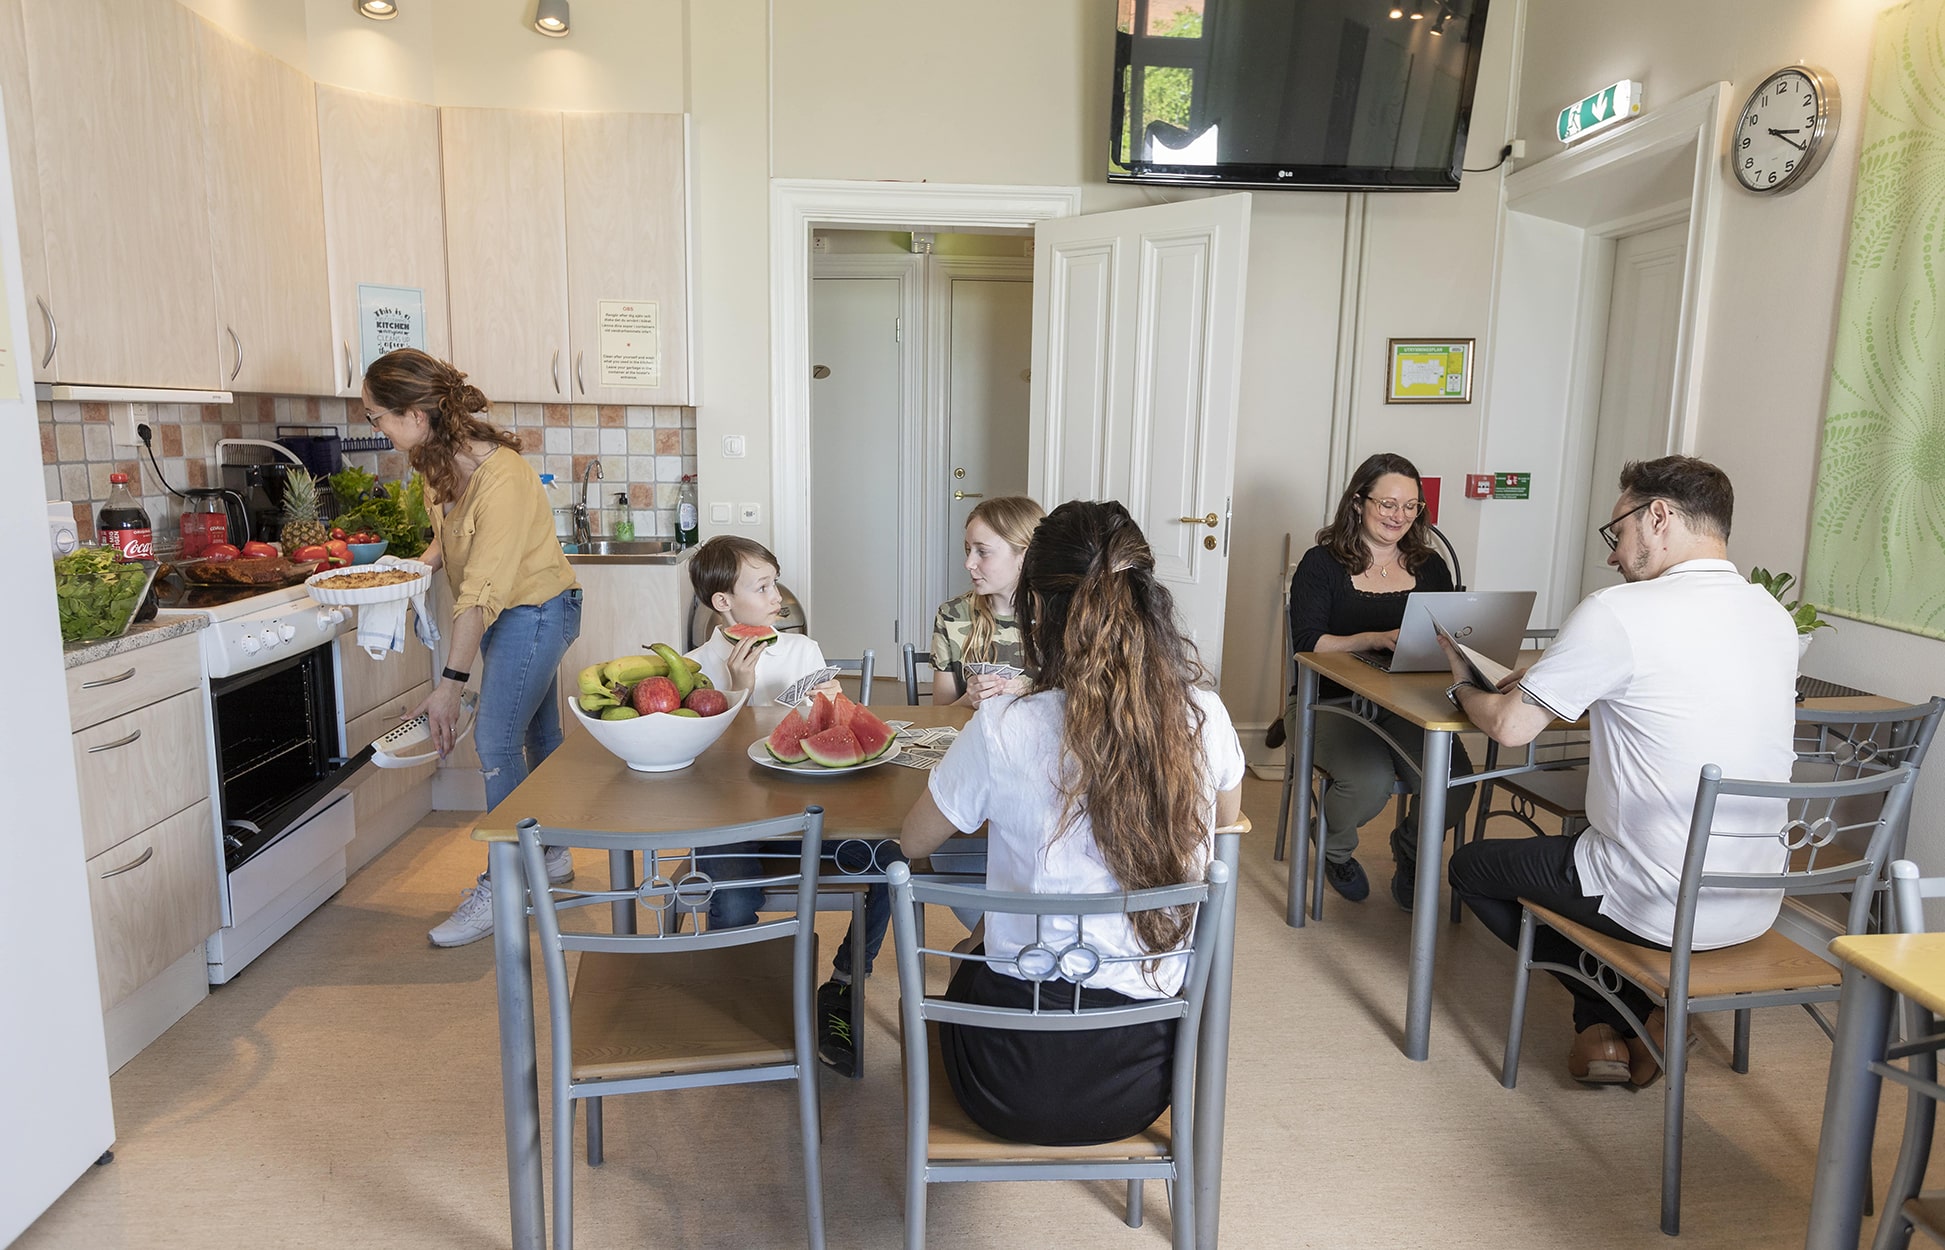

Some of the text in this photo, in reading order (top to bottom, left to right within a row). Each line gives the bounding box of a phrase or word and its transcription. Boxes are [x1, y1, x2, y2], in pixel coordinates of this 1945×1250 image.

[1776, 81, 1788, 95] 12
[1796, 81, 1800, 93] 1
[1761, 95, 1768, 108] 11
[1802, 94, 1812, 107] 2
[1749, 114, 1759, 127] 10
[1805, 115, 1815, 129] 3
[1742, 137, 1751, 150] 9
[1798, 138, 1807, 151] 4
[1745, 157, 1754, 169] 8
[1784, 160, 1794, 173] 5
[1754, 170, 1762, 183] 7
[1768, 171, 1777, 184] 6
[374, 306, 392, 317] This
[394, 308, 402, 316] is
[376, 321, 410, 330] KITCHEN
